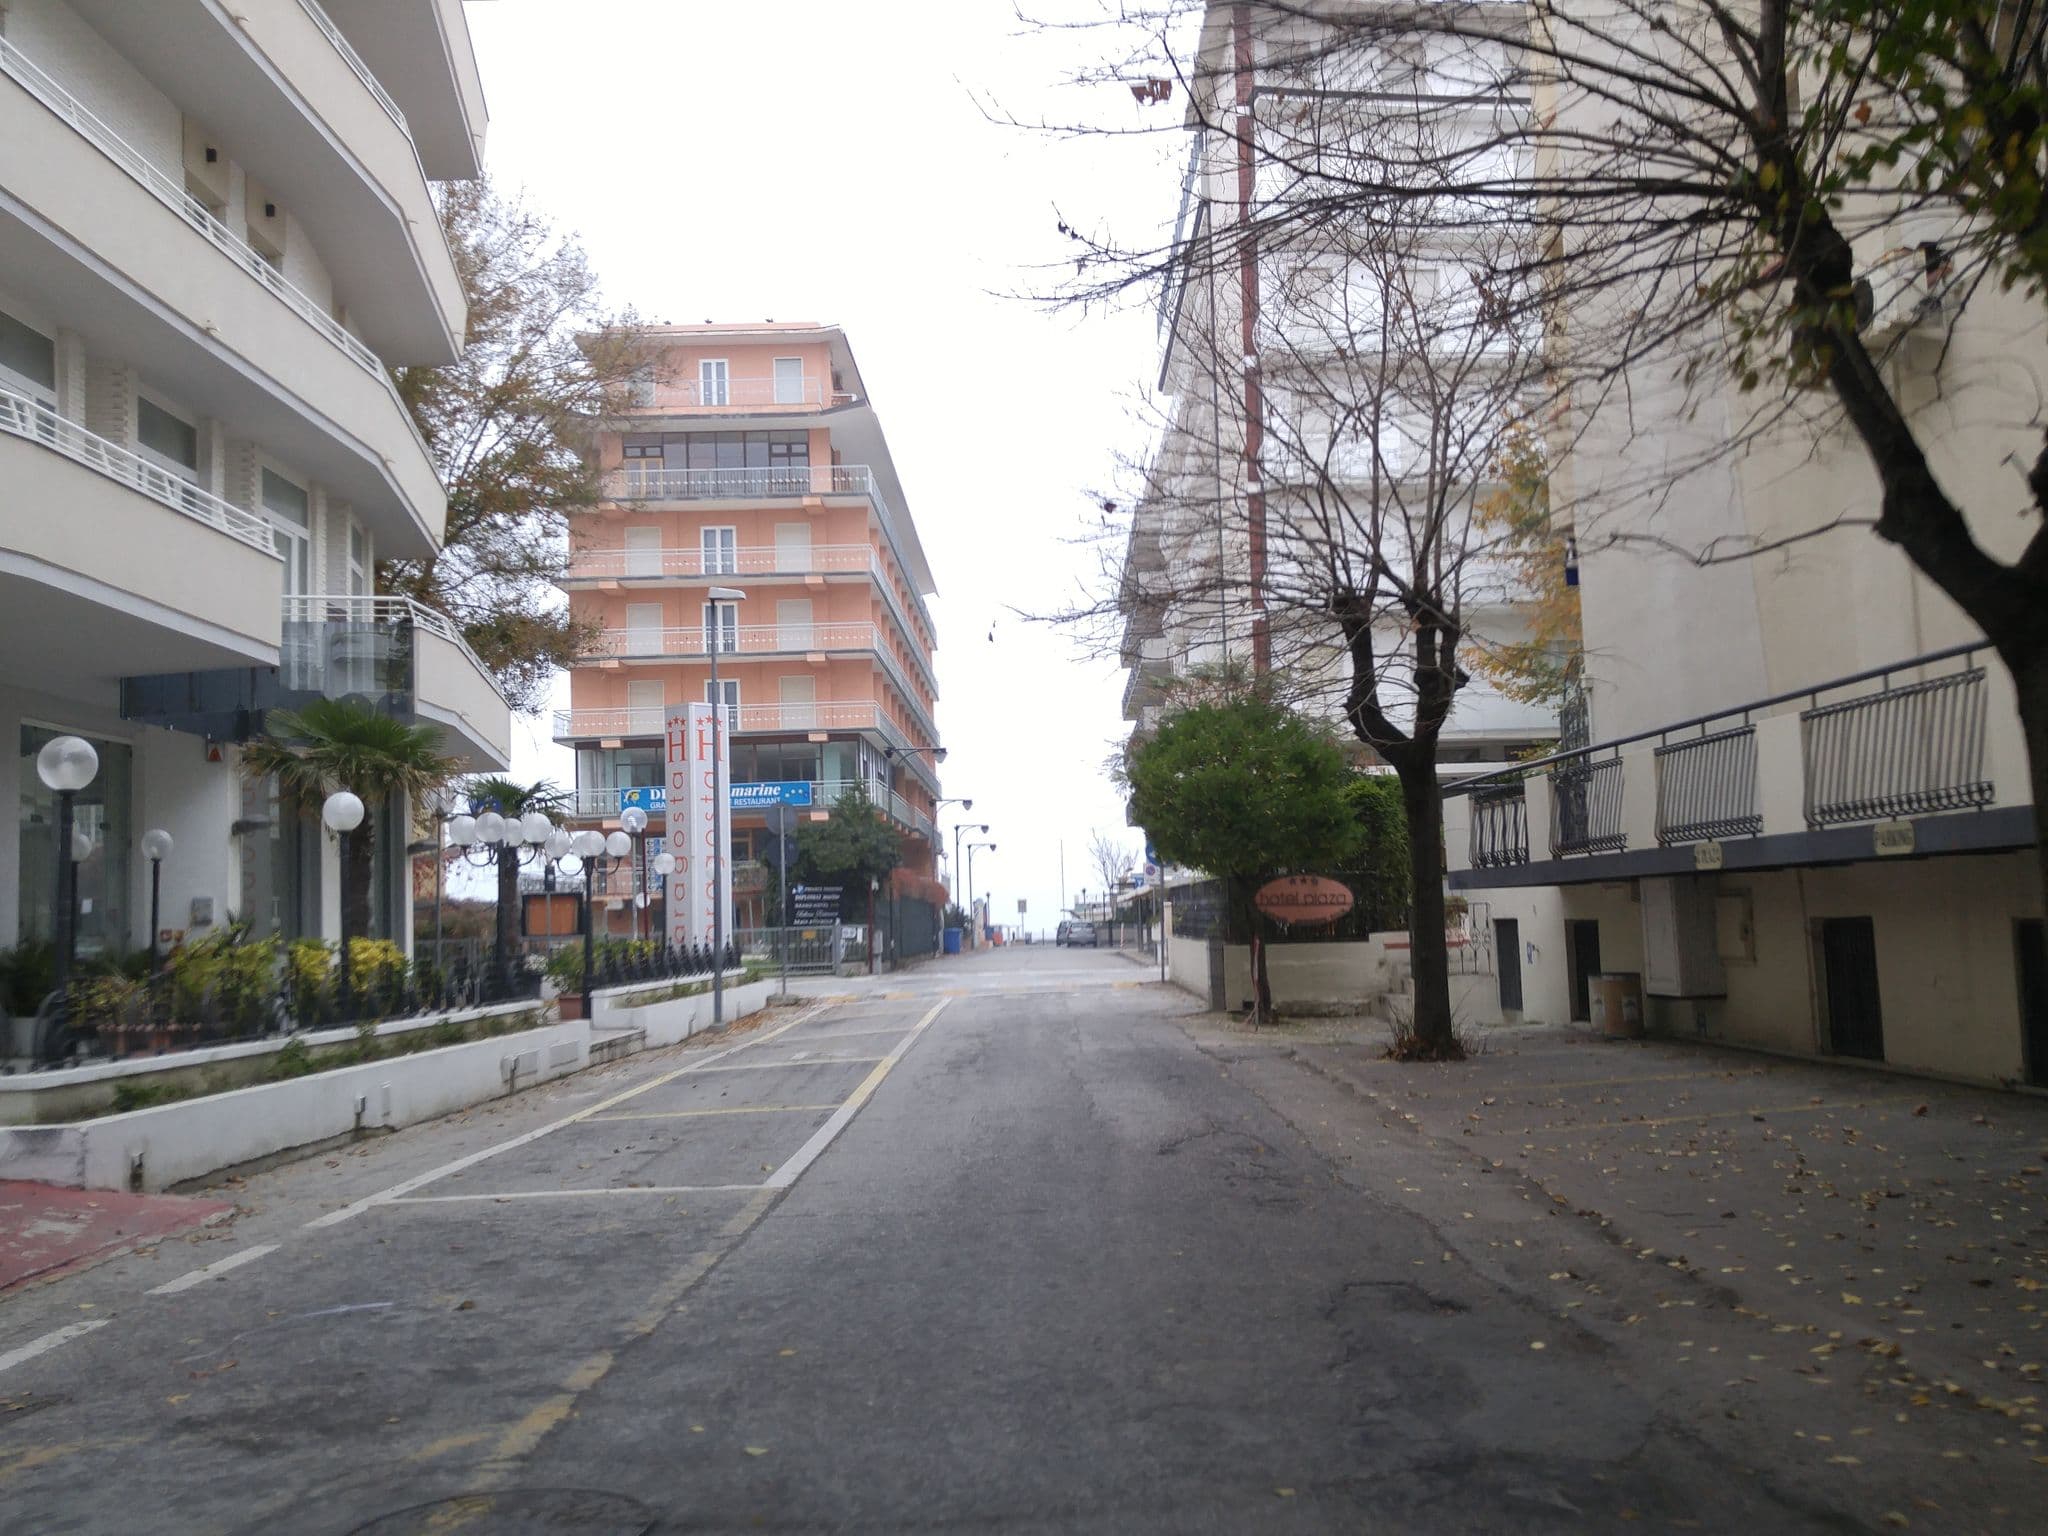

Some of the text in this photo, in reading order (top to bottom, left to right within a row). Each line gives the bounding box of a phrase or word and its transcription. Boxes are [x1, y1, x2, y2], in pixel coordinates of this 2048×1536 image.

[667, 729, 687, 763] H
[731, 783, 781, 797] marine
[1259, 890, 1346, 906] hotel plaza
